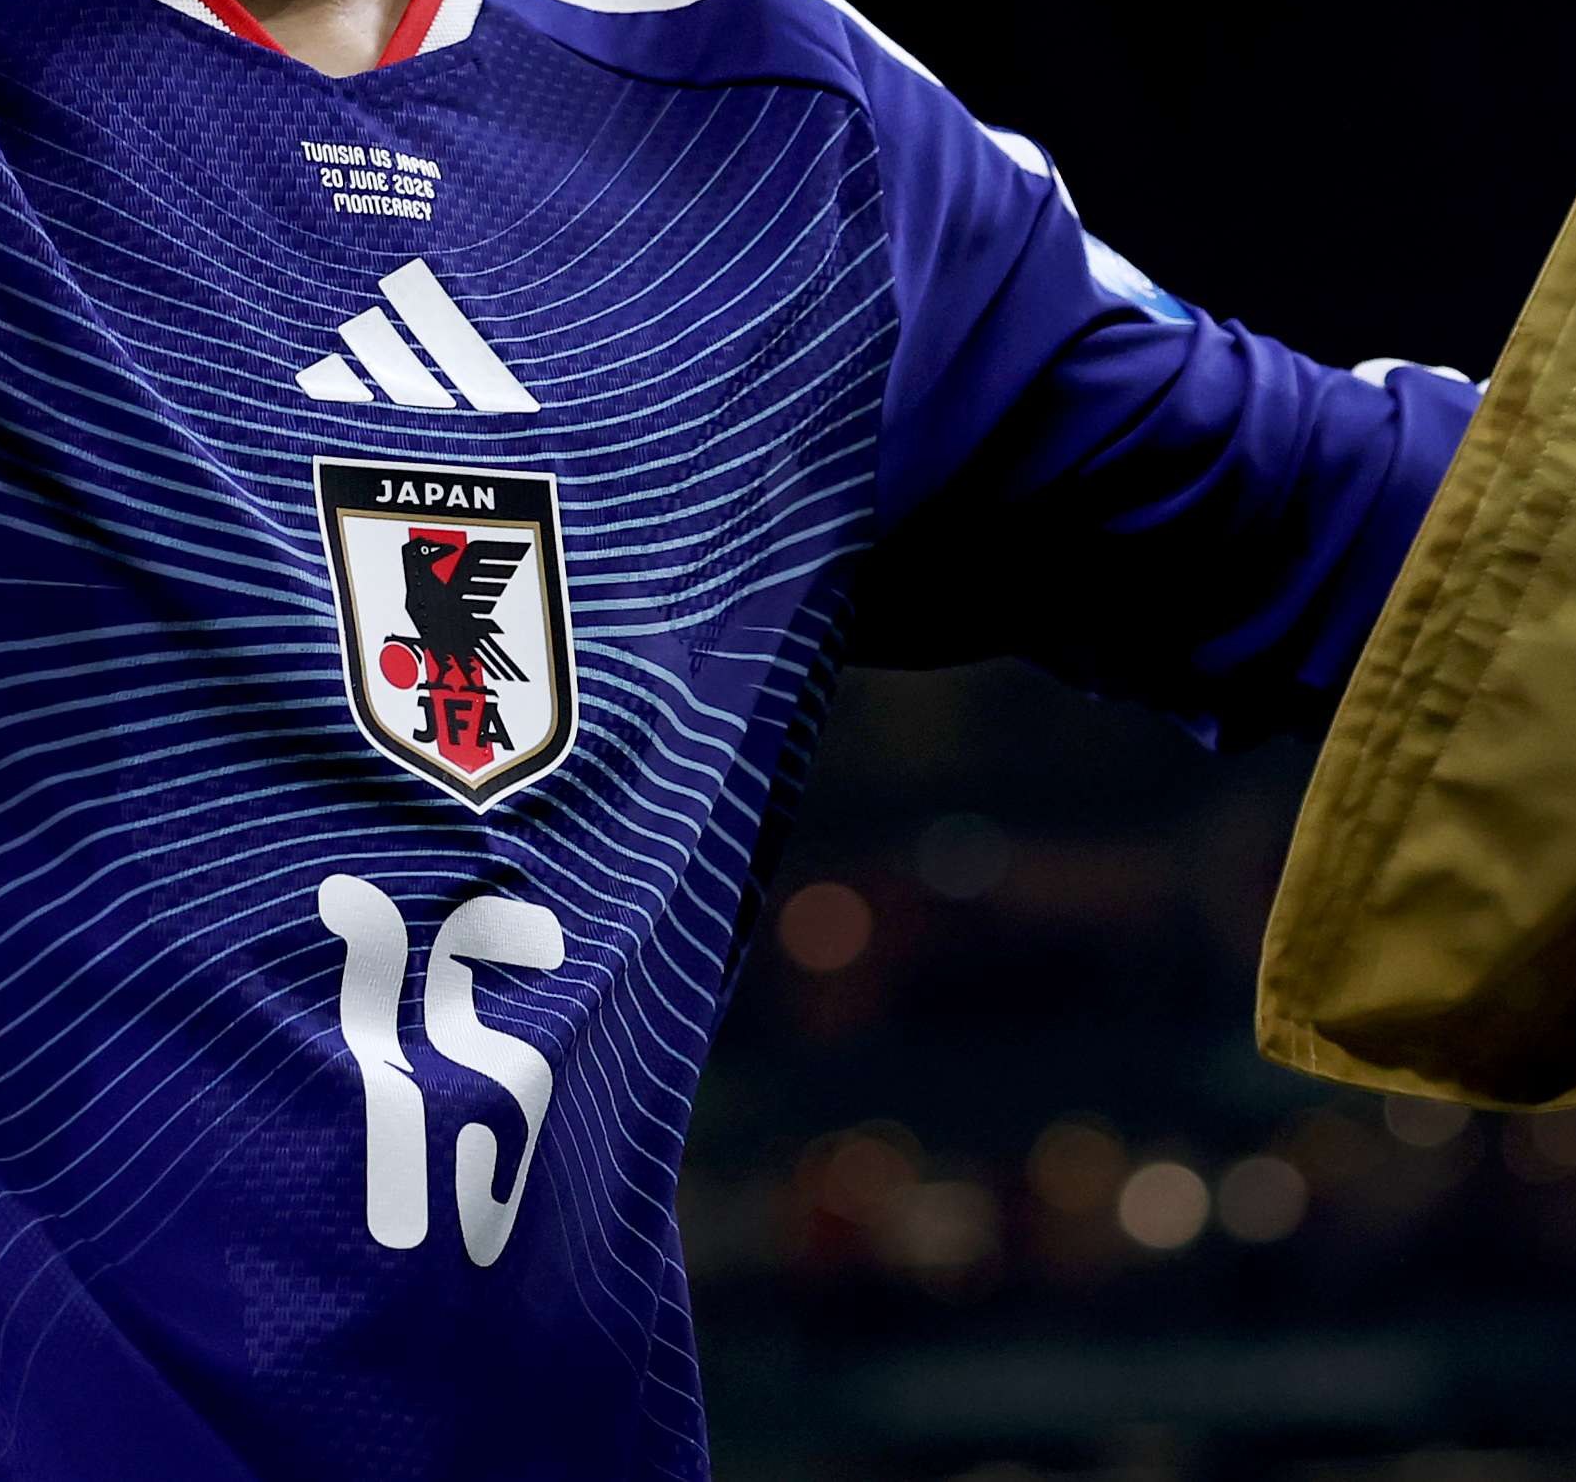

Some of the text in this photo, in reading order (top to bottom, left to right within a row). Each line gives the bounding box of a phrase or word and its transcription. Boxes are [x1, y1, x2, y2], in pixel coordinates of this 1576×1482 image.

[300, 141, 367, 166] TUNISIA
[395, 152, 442, 180] JAPAN
[320, 167, 436, 199] 20 JUNE 2026
[333, 192, 432, 222] MONTERREY
[375, 478, 497, 511] JAPAN
[412, 695, 516, 751] JFA
[317, 872, 566, 1267] 15
